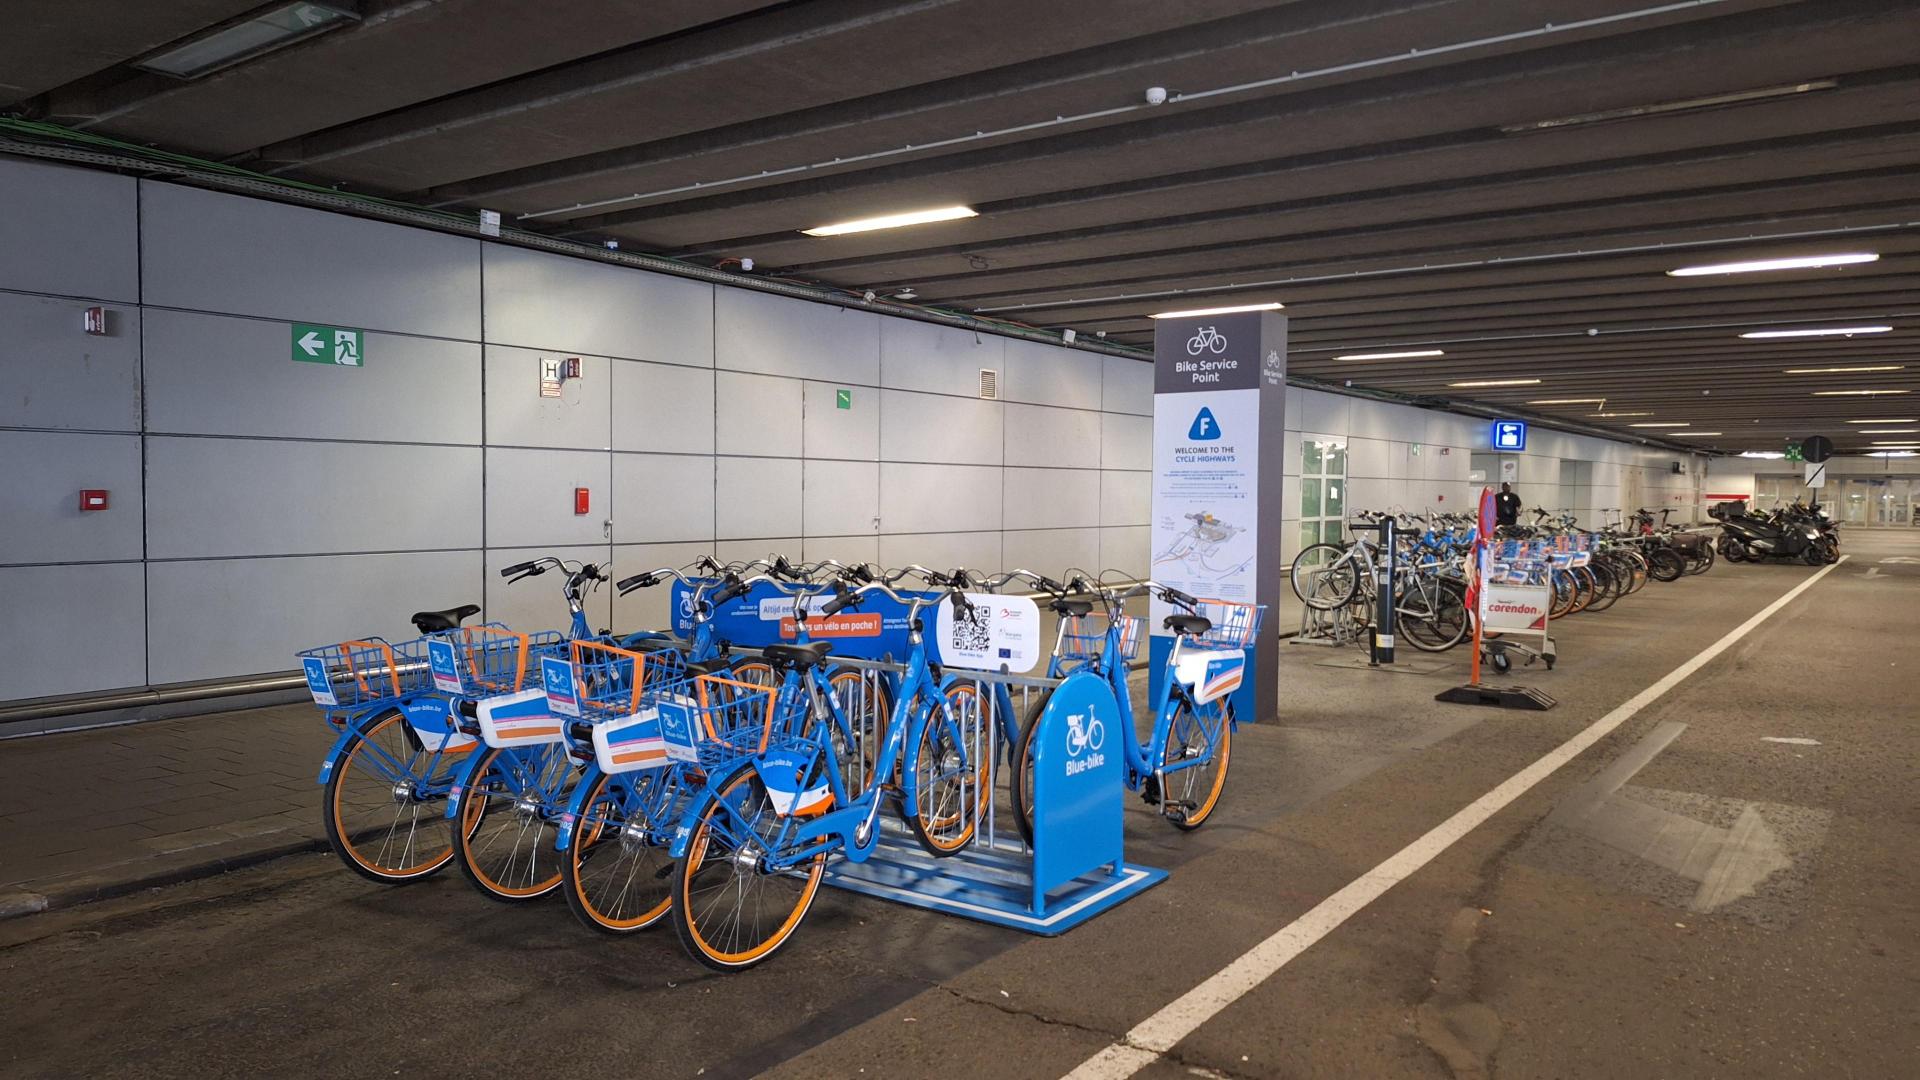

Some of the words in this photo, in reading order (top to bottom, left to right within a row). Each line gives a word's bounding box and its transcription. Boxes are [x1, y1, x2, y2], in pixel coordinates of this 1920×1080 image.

[1175, 361, 1198, 373] Bike
[1199, 358, 1238, 371] Service
[1192, 372, 1220, 383] Point
[1200, 417, 1210, 436] F
[1175, 447, 1208, 455] WELCOME
[1197, 455, 1236, 463] HIGHWAYS
[763, 604, 780, 614] Altijd
[1488, 604, 1538, 614] corendon
[825, 621, 839, 631] vélo
[841, 623, 850, 631] en
[851, 621, 874, 632] poche
[1066, 752, 1105, 777] Blue-bike
